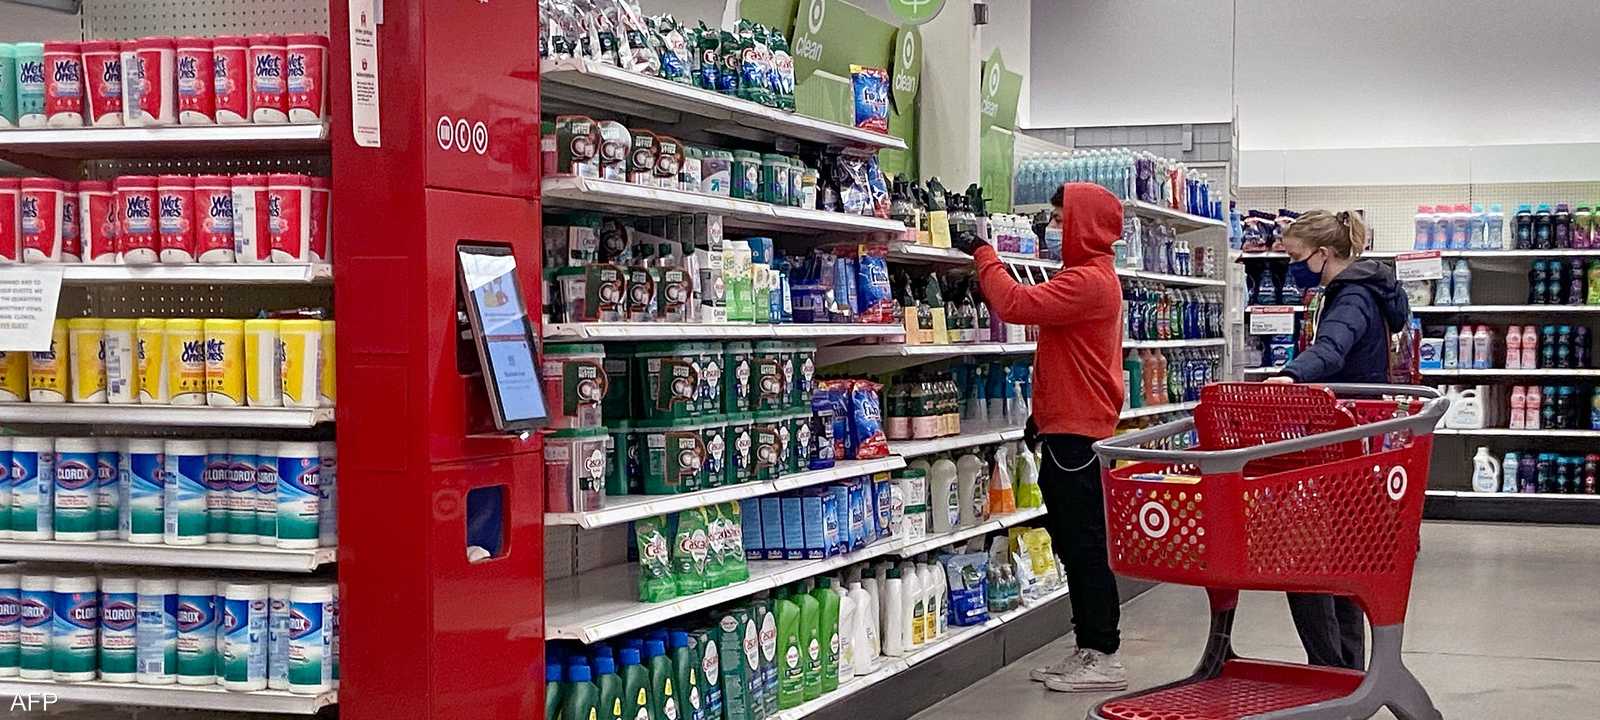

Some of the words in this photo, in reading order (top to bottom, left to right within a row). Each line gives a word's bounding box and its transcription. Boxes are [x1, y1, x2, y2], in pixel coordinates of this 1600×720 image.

[796, 33, 823, 61] clean
[55, 60, 79, 74] Wet
[257, 55, 281, 68] Wet
[55, 72, 79, 82] Ones
[256, 65, 281, 77] Ones
[896, 68, 915, 93] clean
[127, 196, 150, 209] Wet
[213, 196, 232, 208] We
[127, 207, 150, 218] Ones
[57, 467, 90, 480] CLOROX
[105, 608, 136, 621] CLOROX
